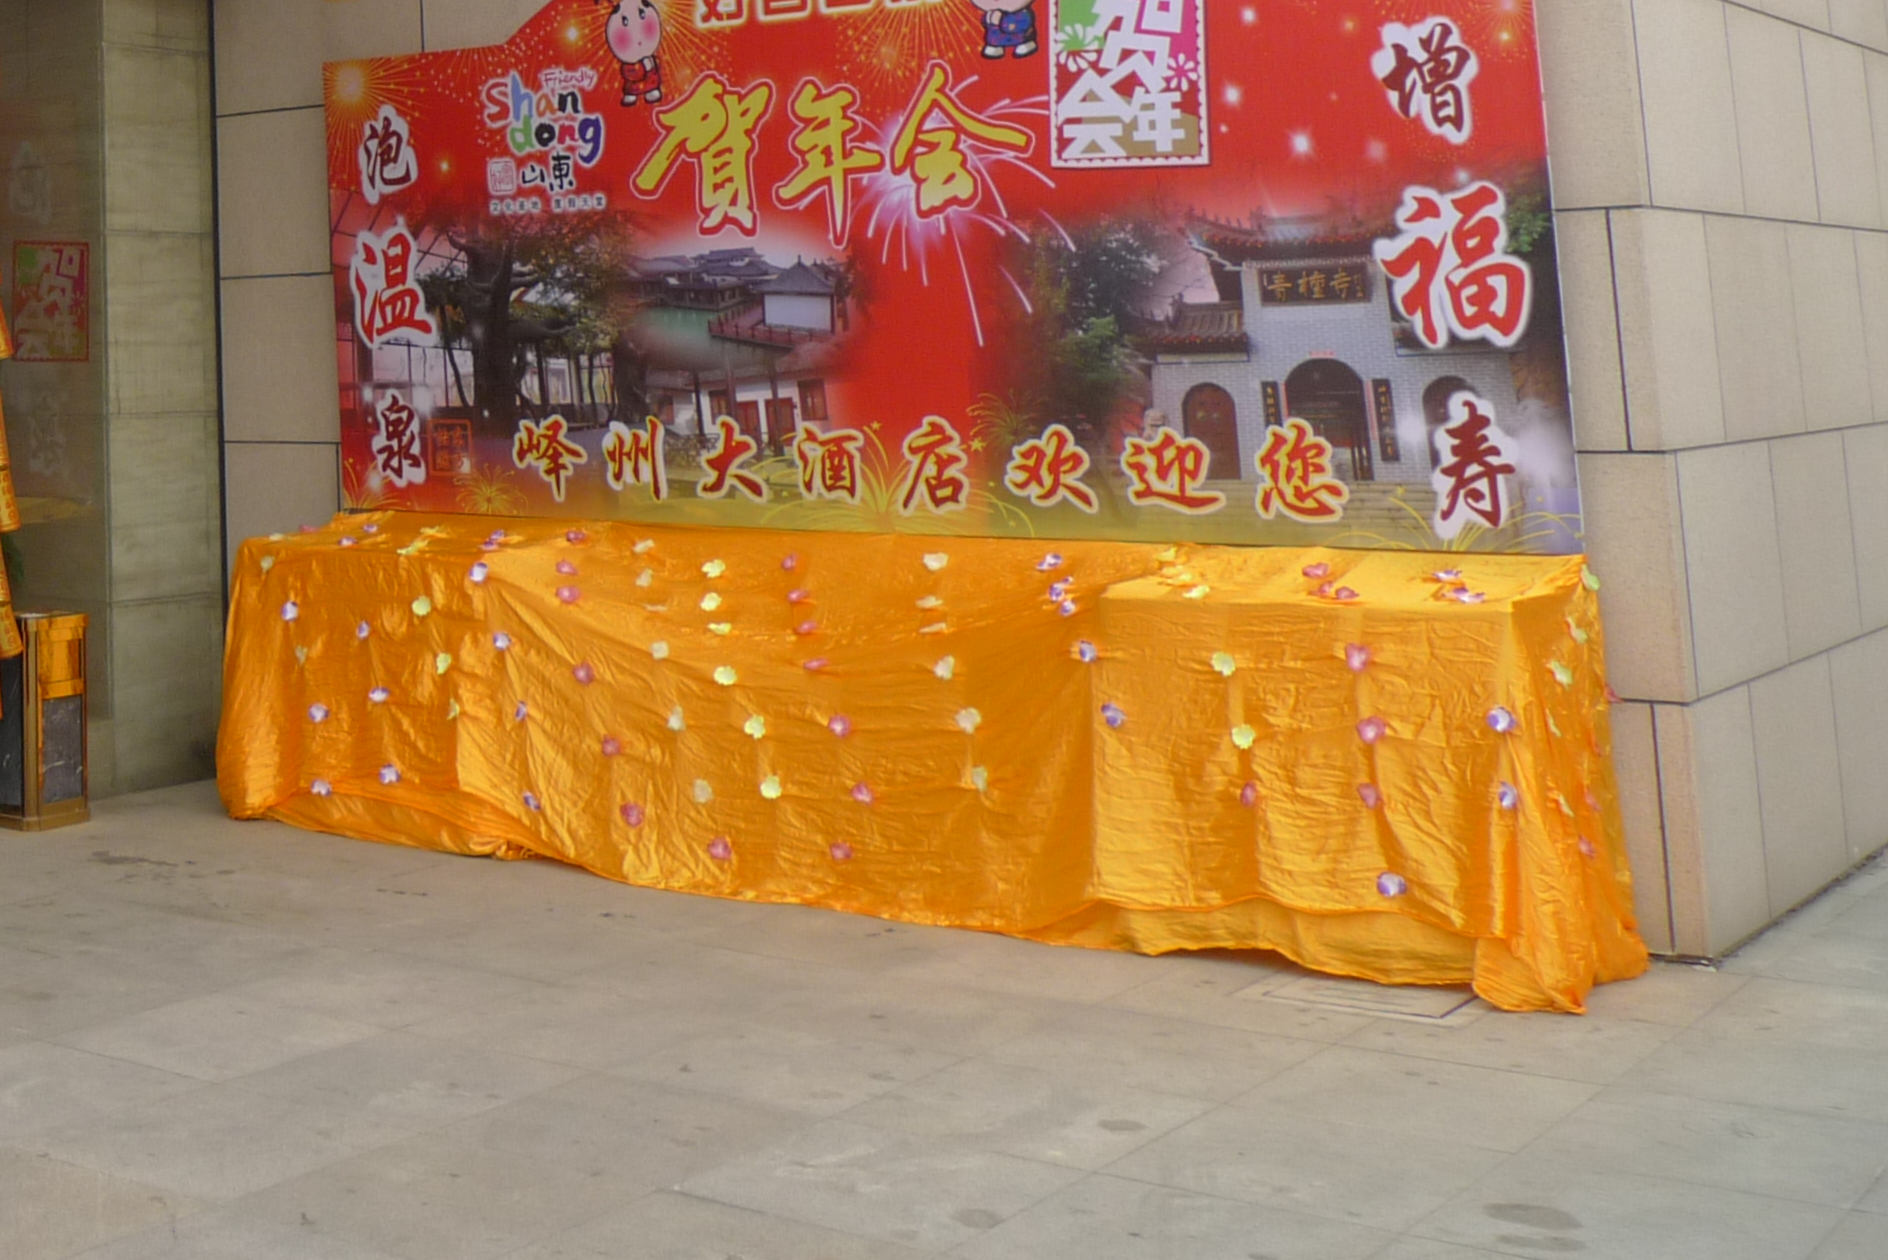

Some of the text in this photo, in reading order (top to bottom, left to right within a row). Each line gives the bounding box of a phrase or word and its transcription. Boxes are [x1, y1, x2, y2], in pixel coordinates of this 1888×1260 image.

[485, 73, 580, 124] Shan
[543, 69, 595, 87] Friendly
[510, 115, 601, 164] dong
